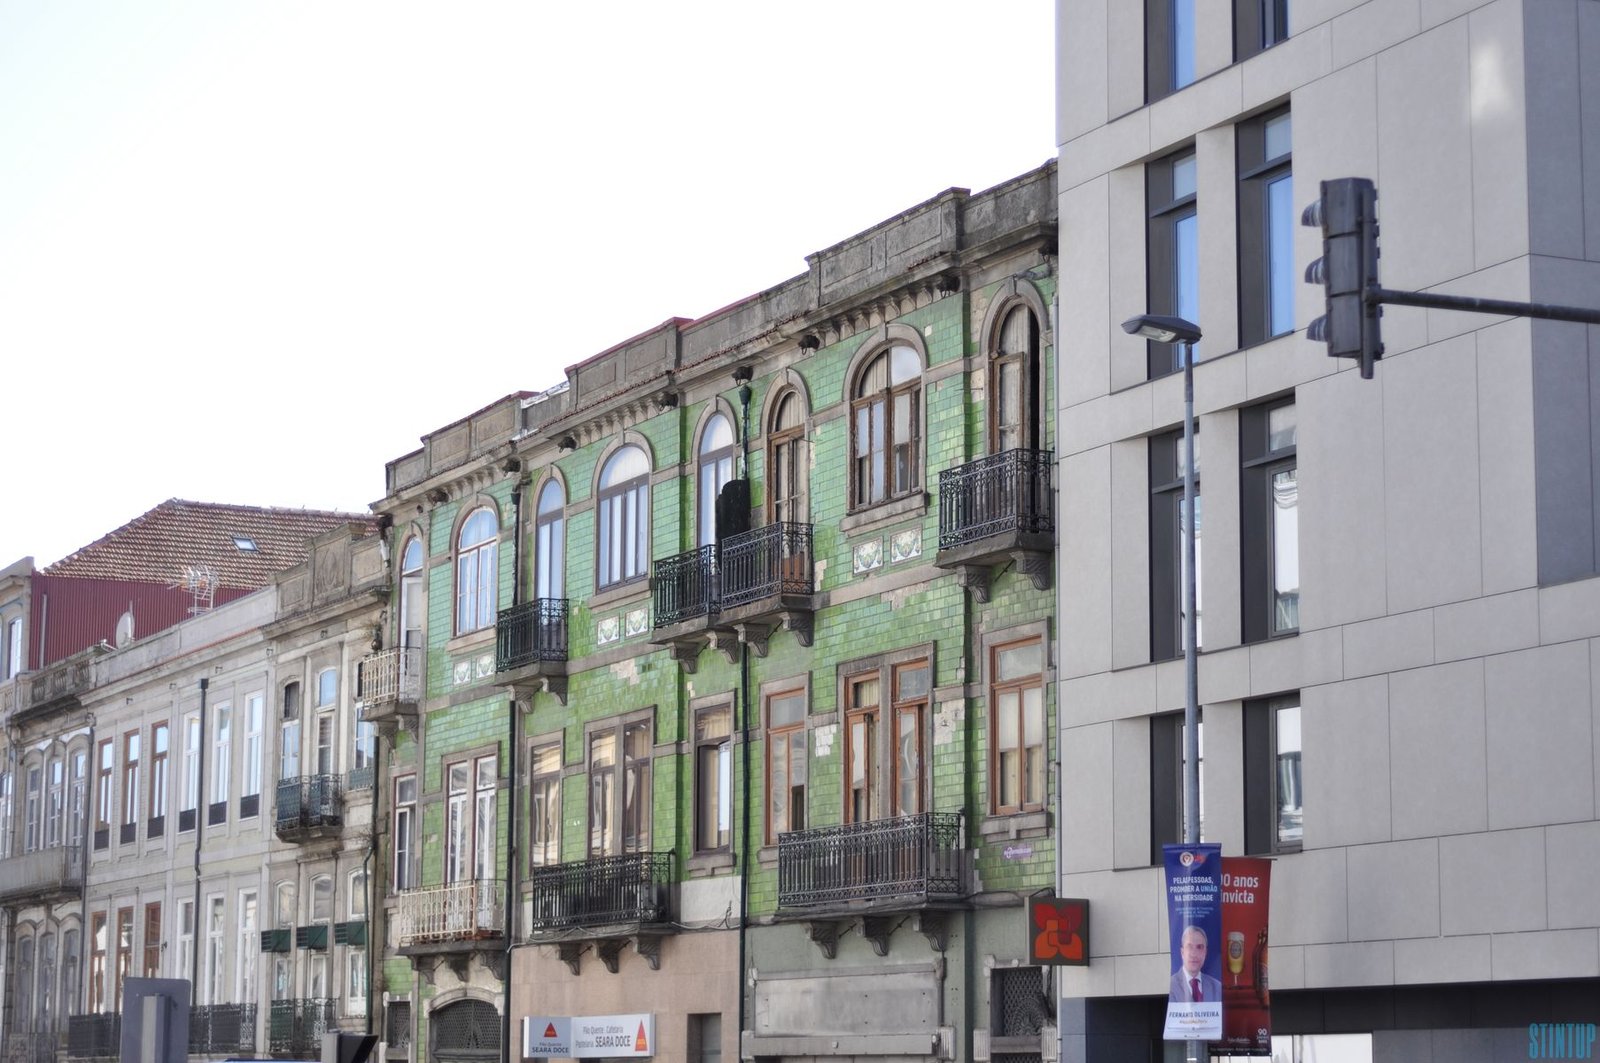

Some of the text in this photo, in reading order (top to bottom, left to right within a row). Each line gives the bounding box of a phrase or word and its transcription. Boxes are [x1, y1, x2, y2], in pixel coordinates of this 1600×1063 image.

[1233, 876, 1259, 888] anos
[1257, 1028, 1268, 1036] 90
[595, 1036, 615, 1048] SEARA
[615, 1035, 631, 1047] DOCE
